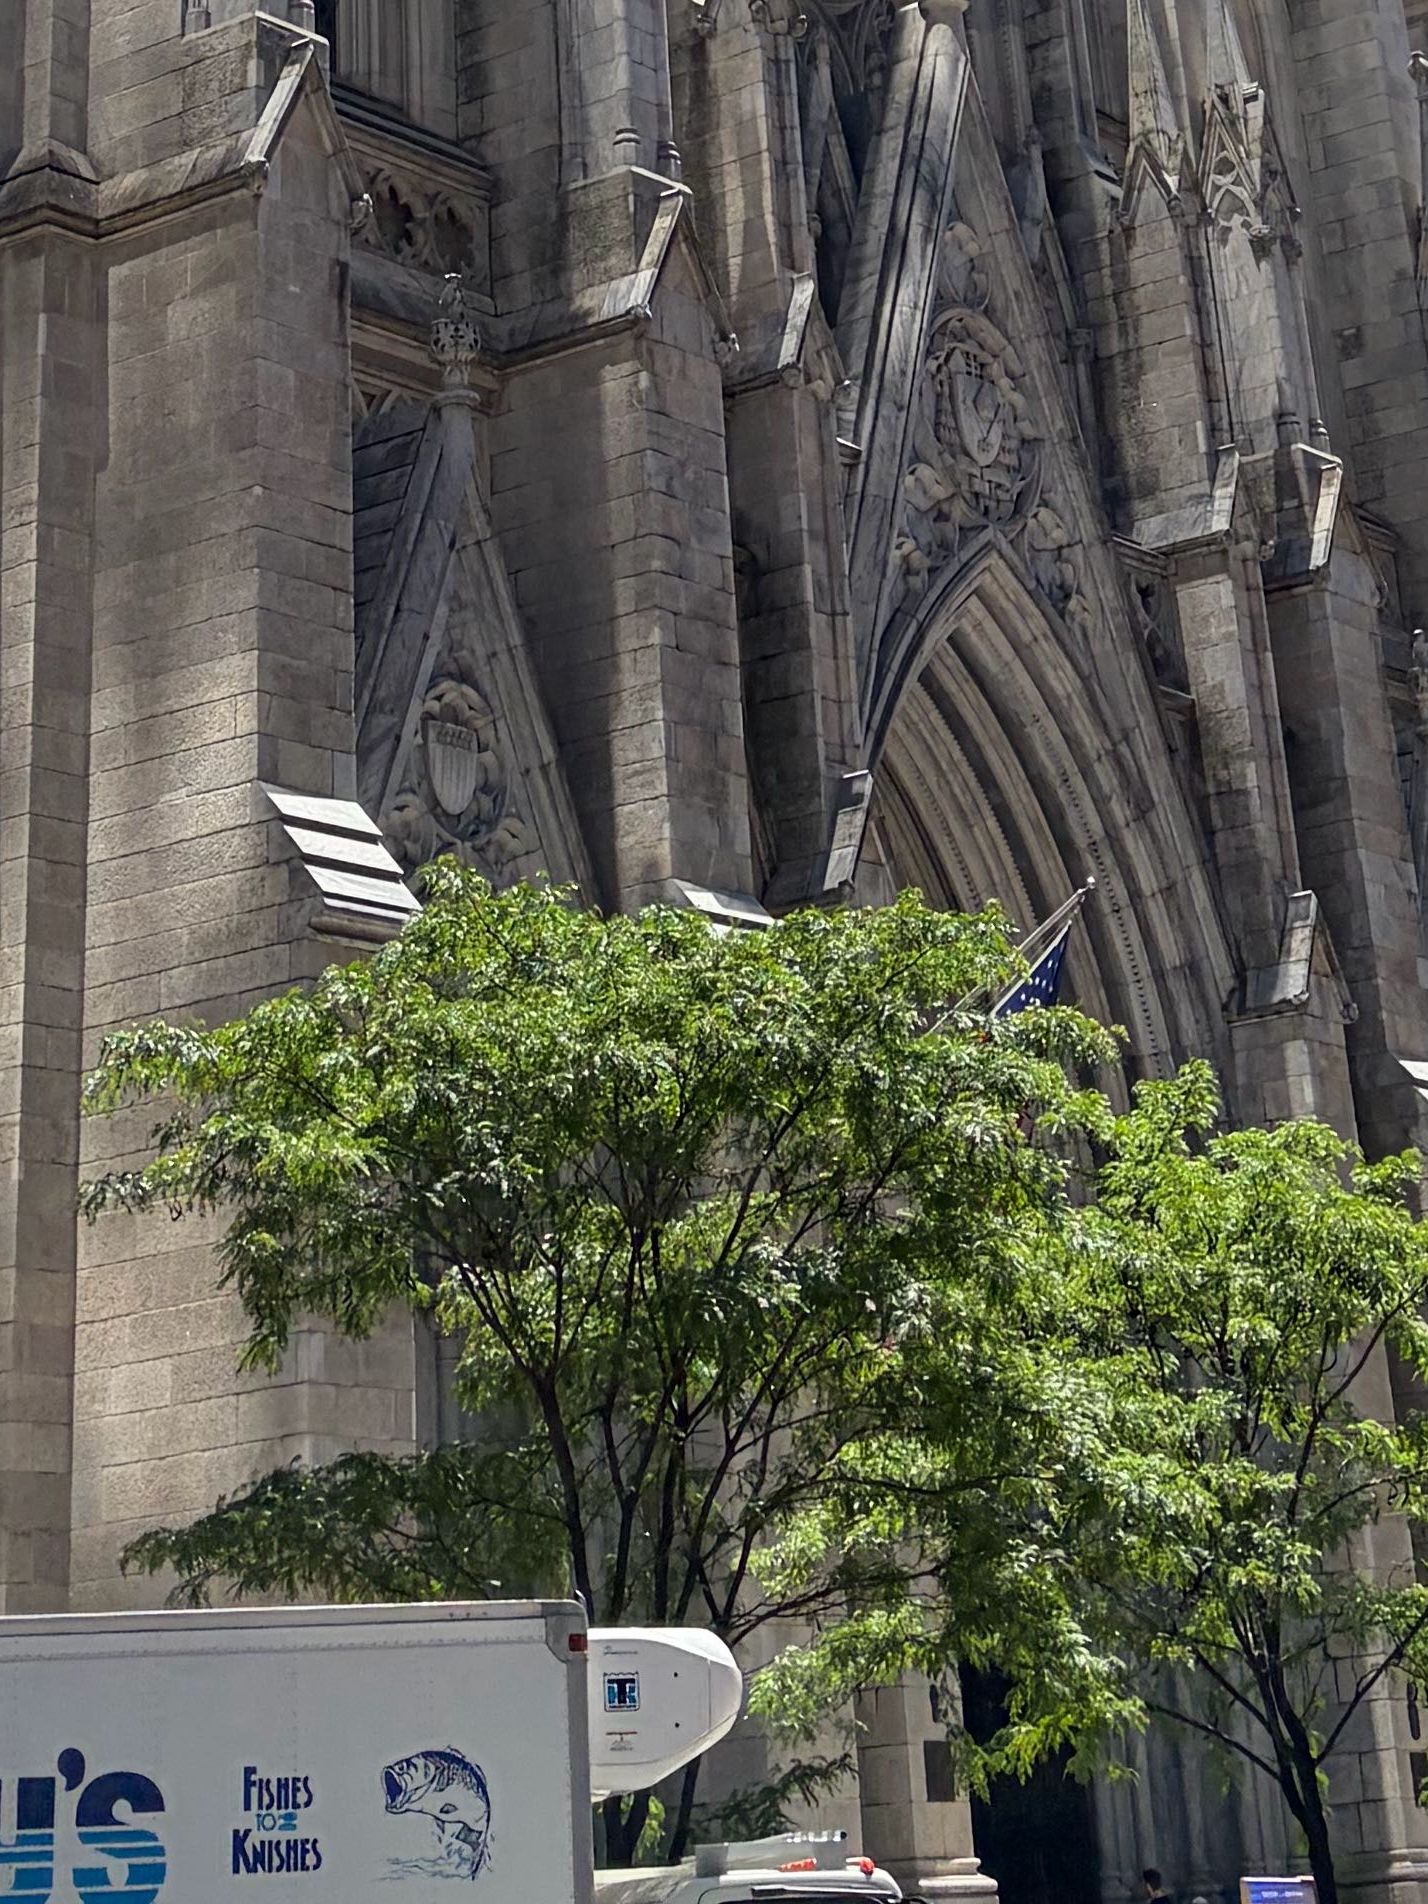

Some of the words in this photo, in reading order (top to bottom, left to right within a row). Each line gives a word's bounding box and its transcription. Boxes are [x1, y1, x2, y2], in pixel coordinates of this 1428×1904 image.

[243, 1766, 313, 1811] FISHES
[255, 1813, 276, 1831] TO
[232, 1829, 322, 1875] KNISHES
